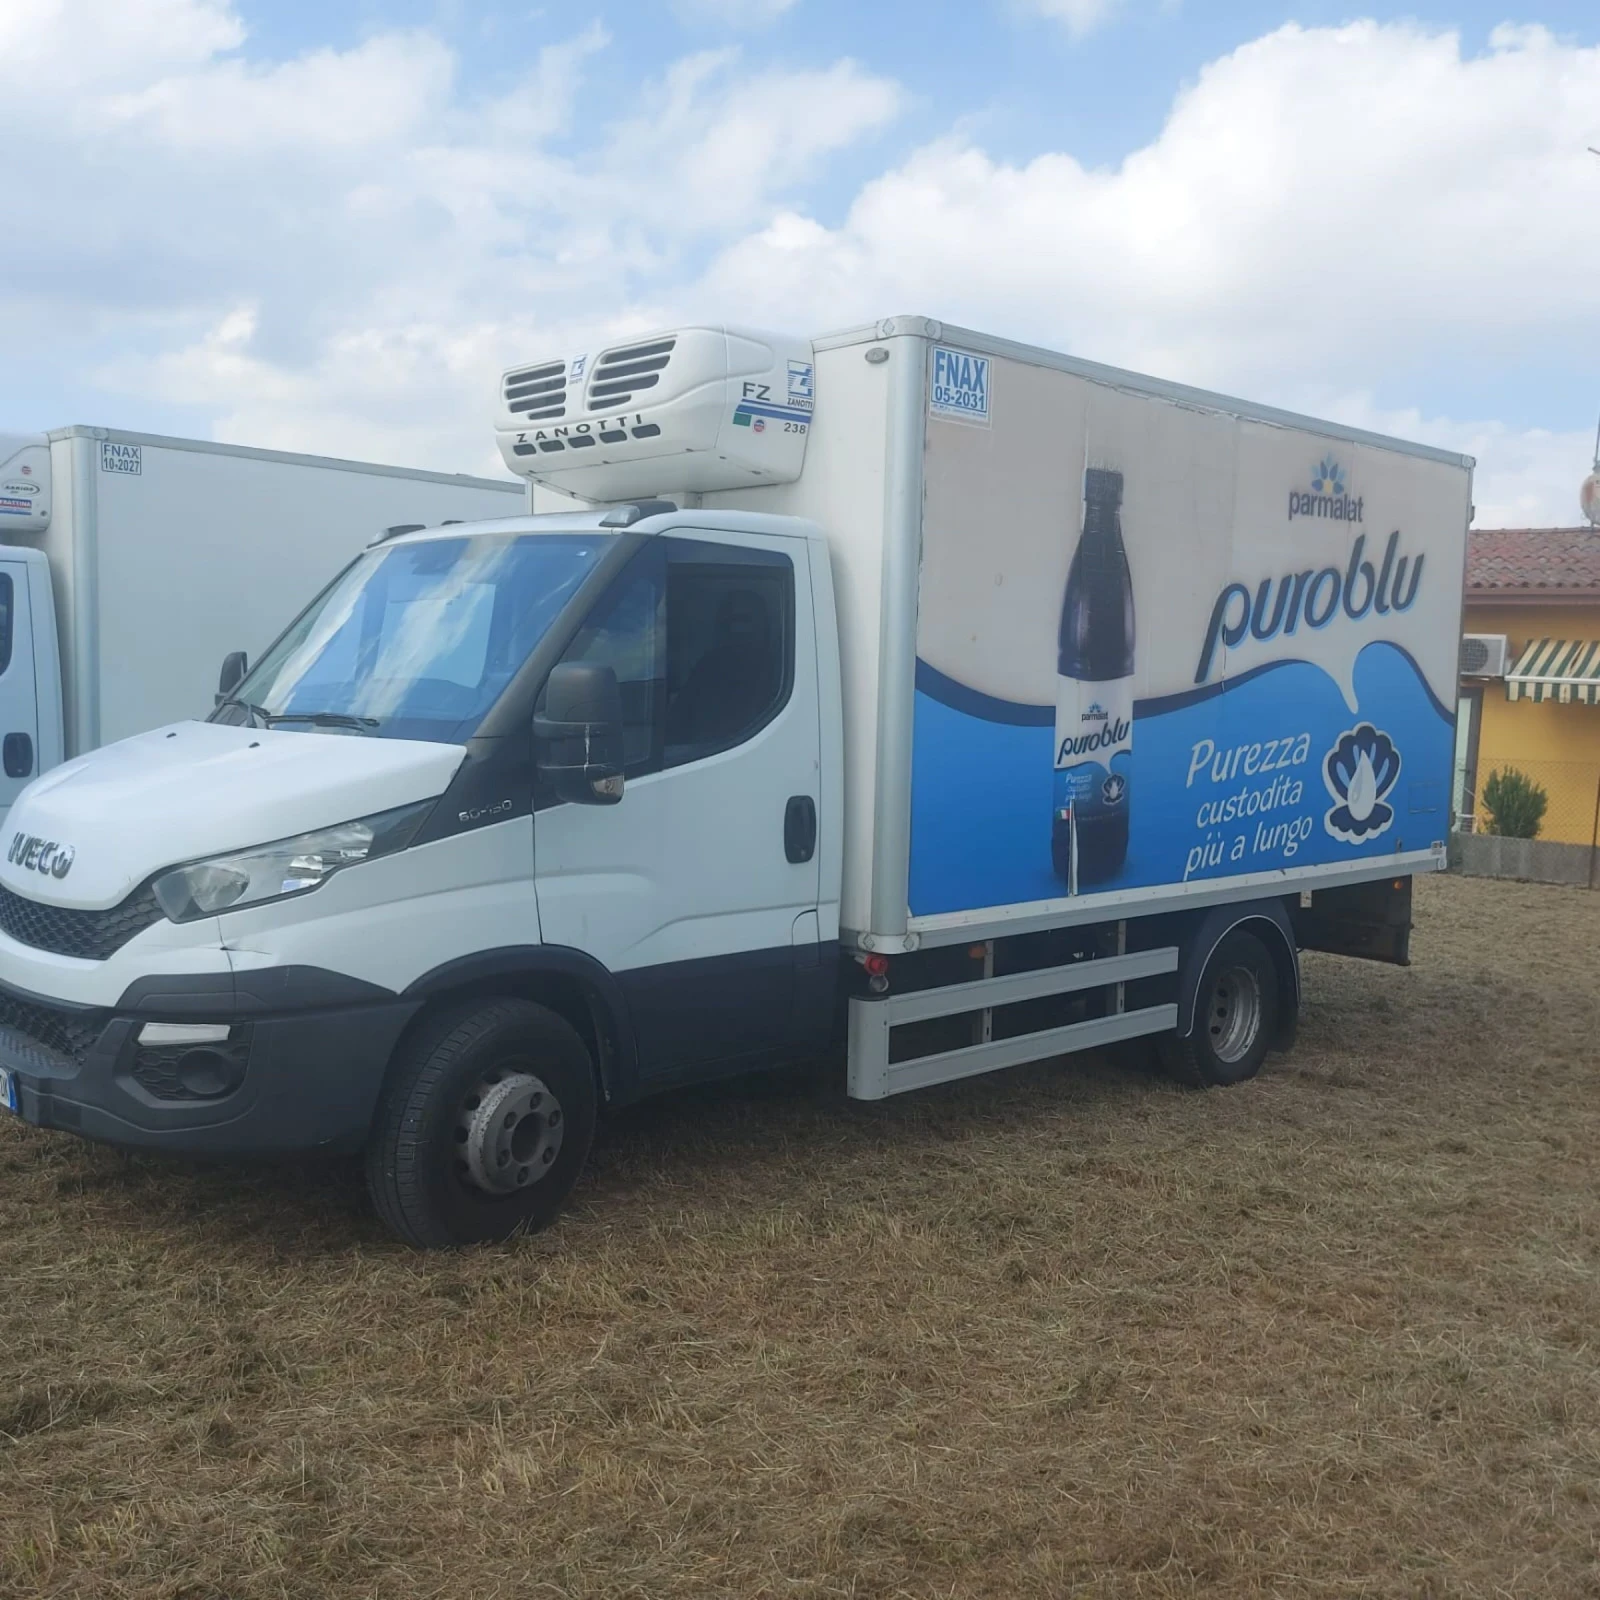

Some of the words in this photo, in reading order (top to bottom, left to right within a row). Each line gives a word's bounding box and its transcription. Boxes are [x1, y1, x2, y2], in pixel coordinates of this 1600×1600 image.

[934, 350, 986, 394] FNAX
[742, 381, 771, 402] FZ
[787, 397, 813, 409] ZANOTTI
[934, 385, 985, 411] 05-2031
[516, 414, 643, 443] ZANOTTI
[783, 422, 807, 434] 238
[103, 443, 140, 460] FNAX
[103, 457, 140, 474] 10-2027
[1287, 490, 1365, 523] parmalat
[1193, 530, 1426, 684] puroblu
[1057, 716, 1130, 765] puroblu
[1186, 732, 1312, 789] Purezza
[1196, 774, 1303, 829] custodita
[7, 831, 76, 880] IVECO
[1183, 831, 1226, 882] più
[1230, 835, 1247, 861] a
[1253, 816, 1313, 857] lungo
